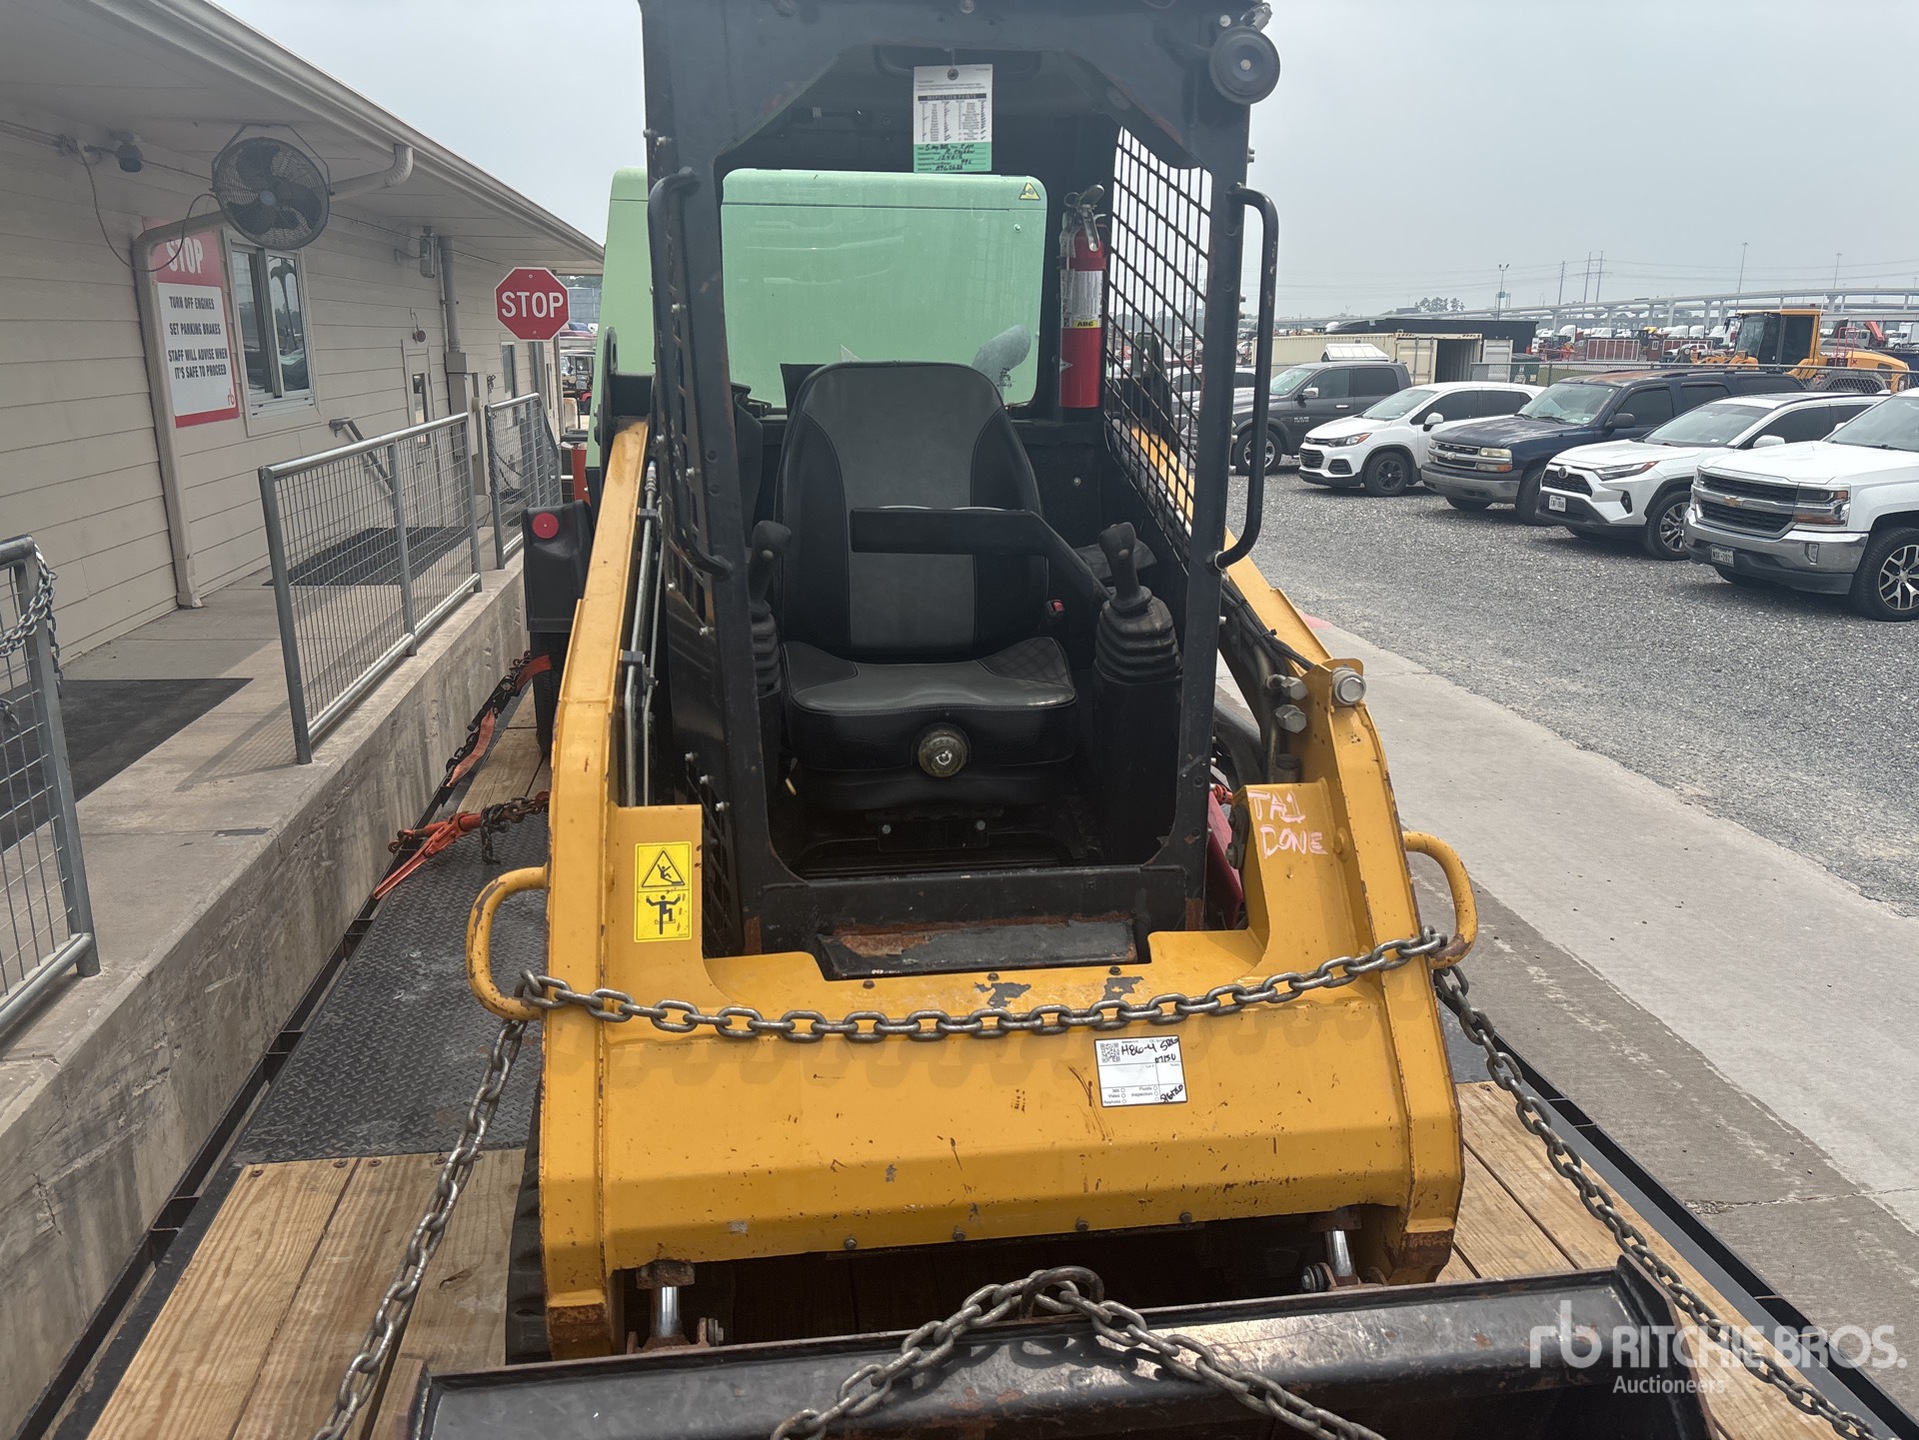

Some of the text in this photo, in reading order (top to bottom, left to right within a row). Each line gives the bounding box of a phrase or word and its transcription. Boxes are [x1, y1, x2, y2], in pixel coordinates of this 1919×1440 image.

[166, 237, 204, 274] STOP
[169, 296, 215, 310] TURN OFF ENGINES
[501, 291, 564, 318] STOP
[169, 322, 221, 336] SET PARKING BRAKES
[168, 347, 228, 362] STAFF WILL ADVISE WHEN
[174, 364, 227, 379] IT'S SAFE TO PROCEED
[1260, 824, 1328, 859] DONE
